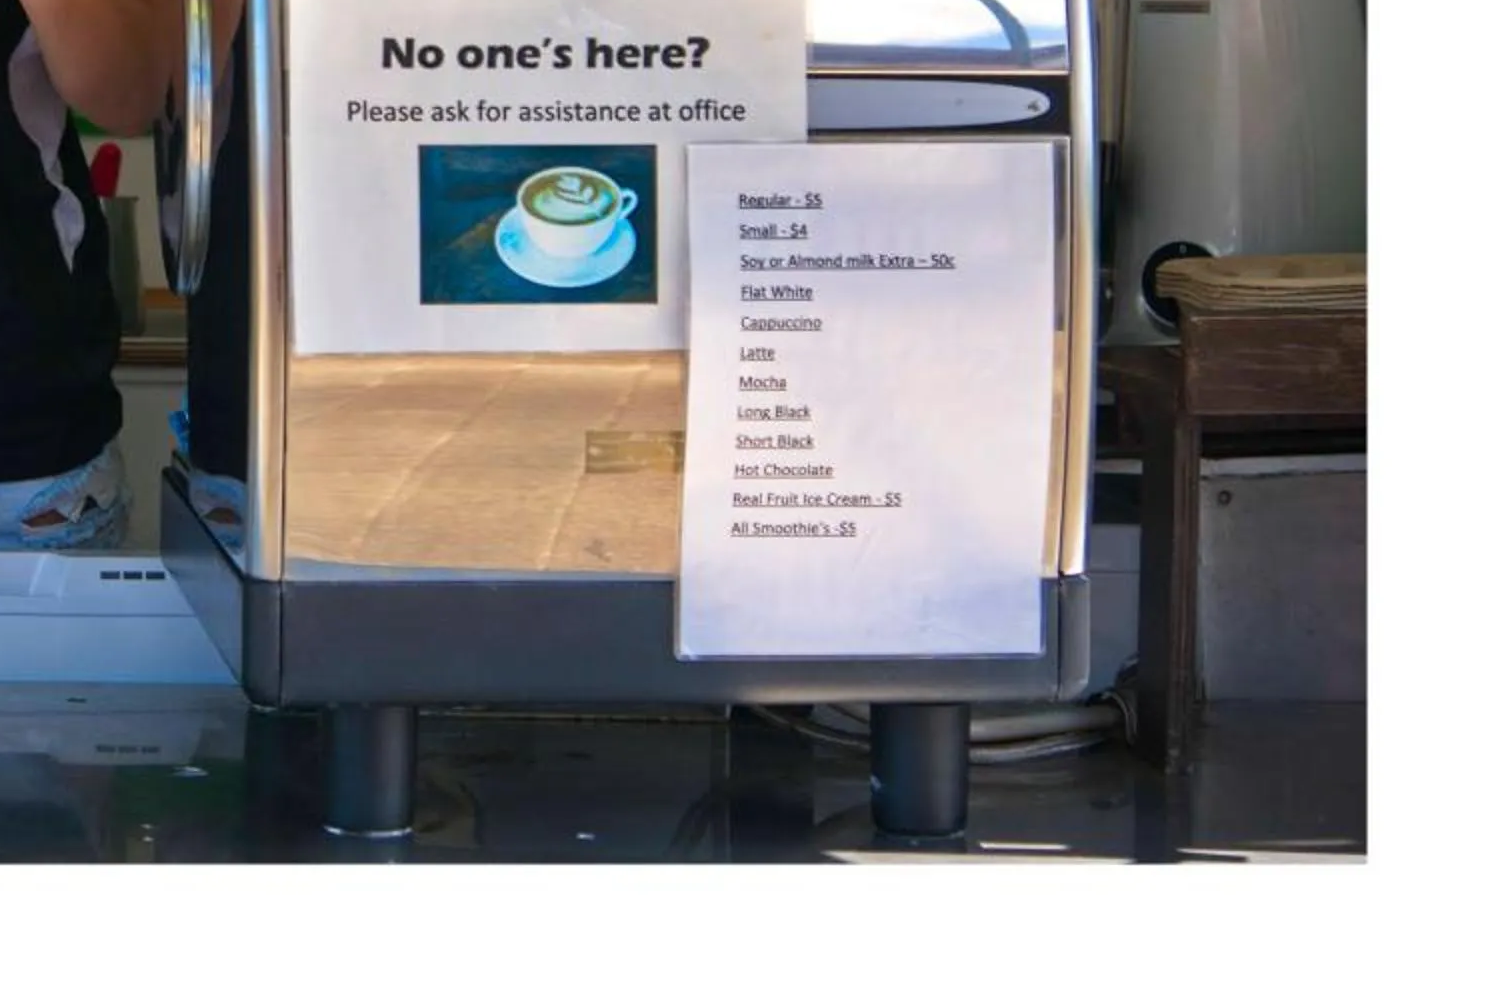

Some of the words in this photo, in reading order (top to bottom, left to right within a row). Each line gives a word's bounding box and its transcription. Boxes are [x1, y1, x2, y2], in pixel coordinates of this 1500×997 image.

[382, 37, 444, 69] No
[586, 36, 710, 69] here?
[347, 100, 423, 122] Please
[431, 100, 470, 122] ask
[477, 99, 511, 121] for
[519, 101, 641, 122] assistance
[648, 103, 672, 122] at
[679, 99, 746, 122] office
[739, 193, 791, 209] Regular
[740, 223, 777, 239] Small
[790, 223, 808, 239] $4
[740, 254, 765, 270] Soy
[769, 257, 784, 270] or
[788, 253, 843, 270] Almond
[846, 254, 875, 269] milk
[879, 254, 915, 269] Extra
[931, 253, 956, 269] 50c
[740, 285, 767, 301] Flat
[771, 284, 813, 301] White
[740, 316, 822, 331] Cappuccino
[740, 346, 775, 361] Latte
[739, 376, 787, 391] Mocha
[737, 406, 772, 421] Long
[775, 404, 812, 420] Black
[735, 434, 775, 449] Short
[777, 434, 815, 449] Black
[734, 464, 760, 479] Hot
[763, 464, 834, 479] Chocolate
[733, 492, 763, 507] Real
[767, 492, 799, 507] Fruit
[803, 493, 823, 507] Ice
[827, 492, 873, 507] Cream
[730, 522, 749, 537] All
